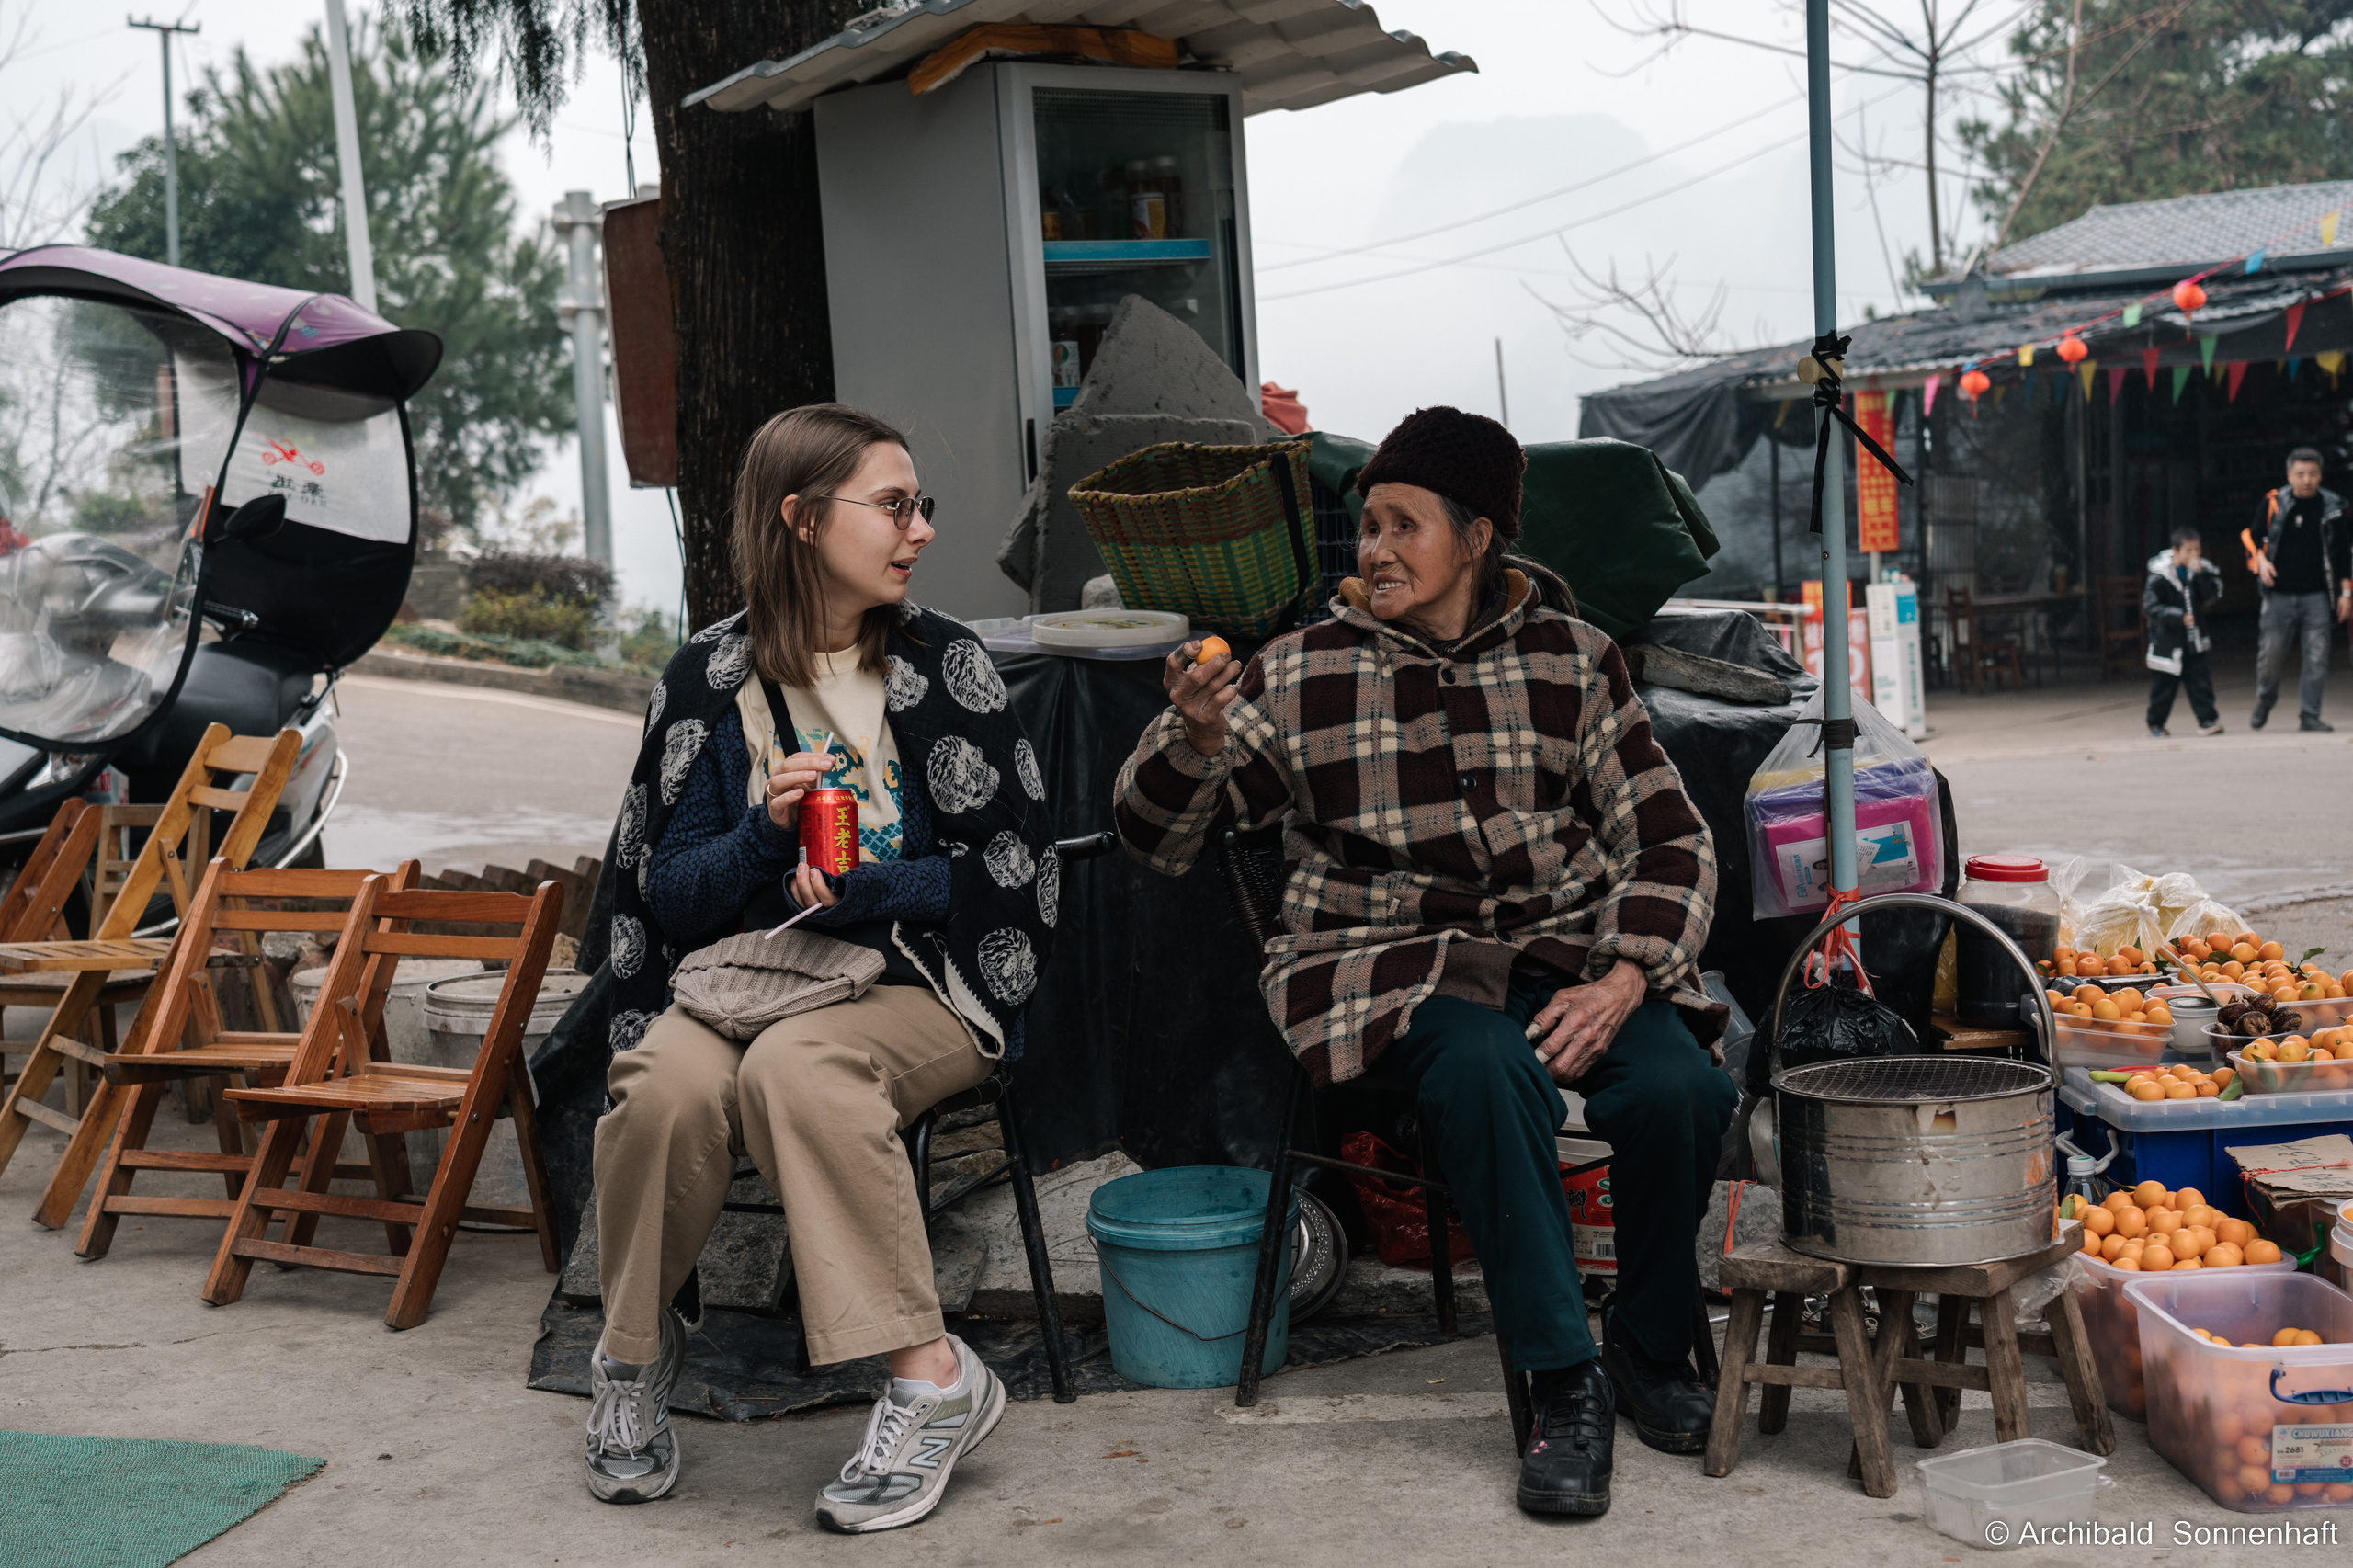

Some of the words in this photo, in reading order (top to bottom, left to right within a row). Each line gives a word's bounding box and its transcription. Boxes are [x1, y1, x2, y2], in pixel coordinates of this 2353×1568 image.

[834, 806, 852, 873] 王老吉
[907, 1437, 954, 1470] N
[2285, 1446, 2304, 1454] 2681
